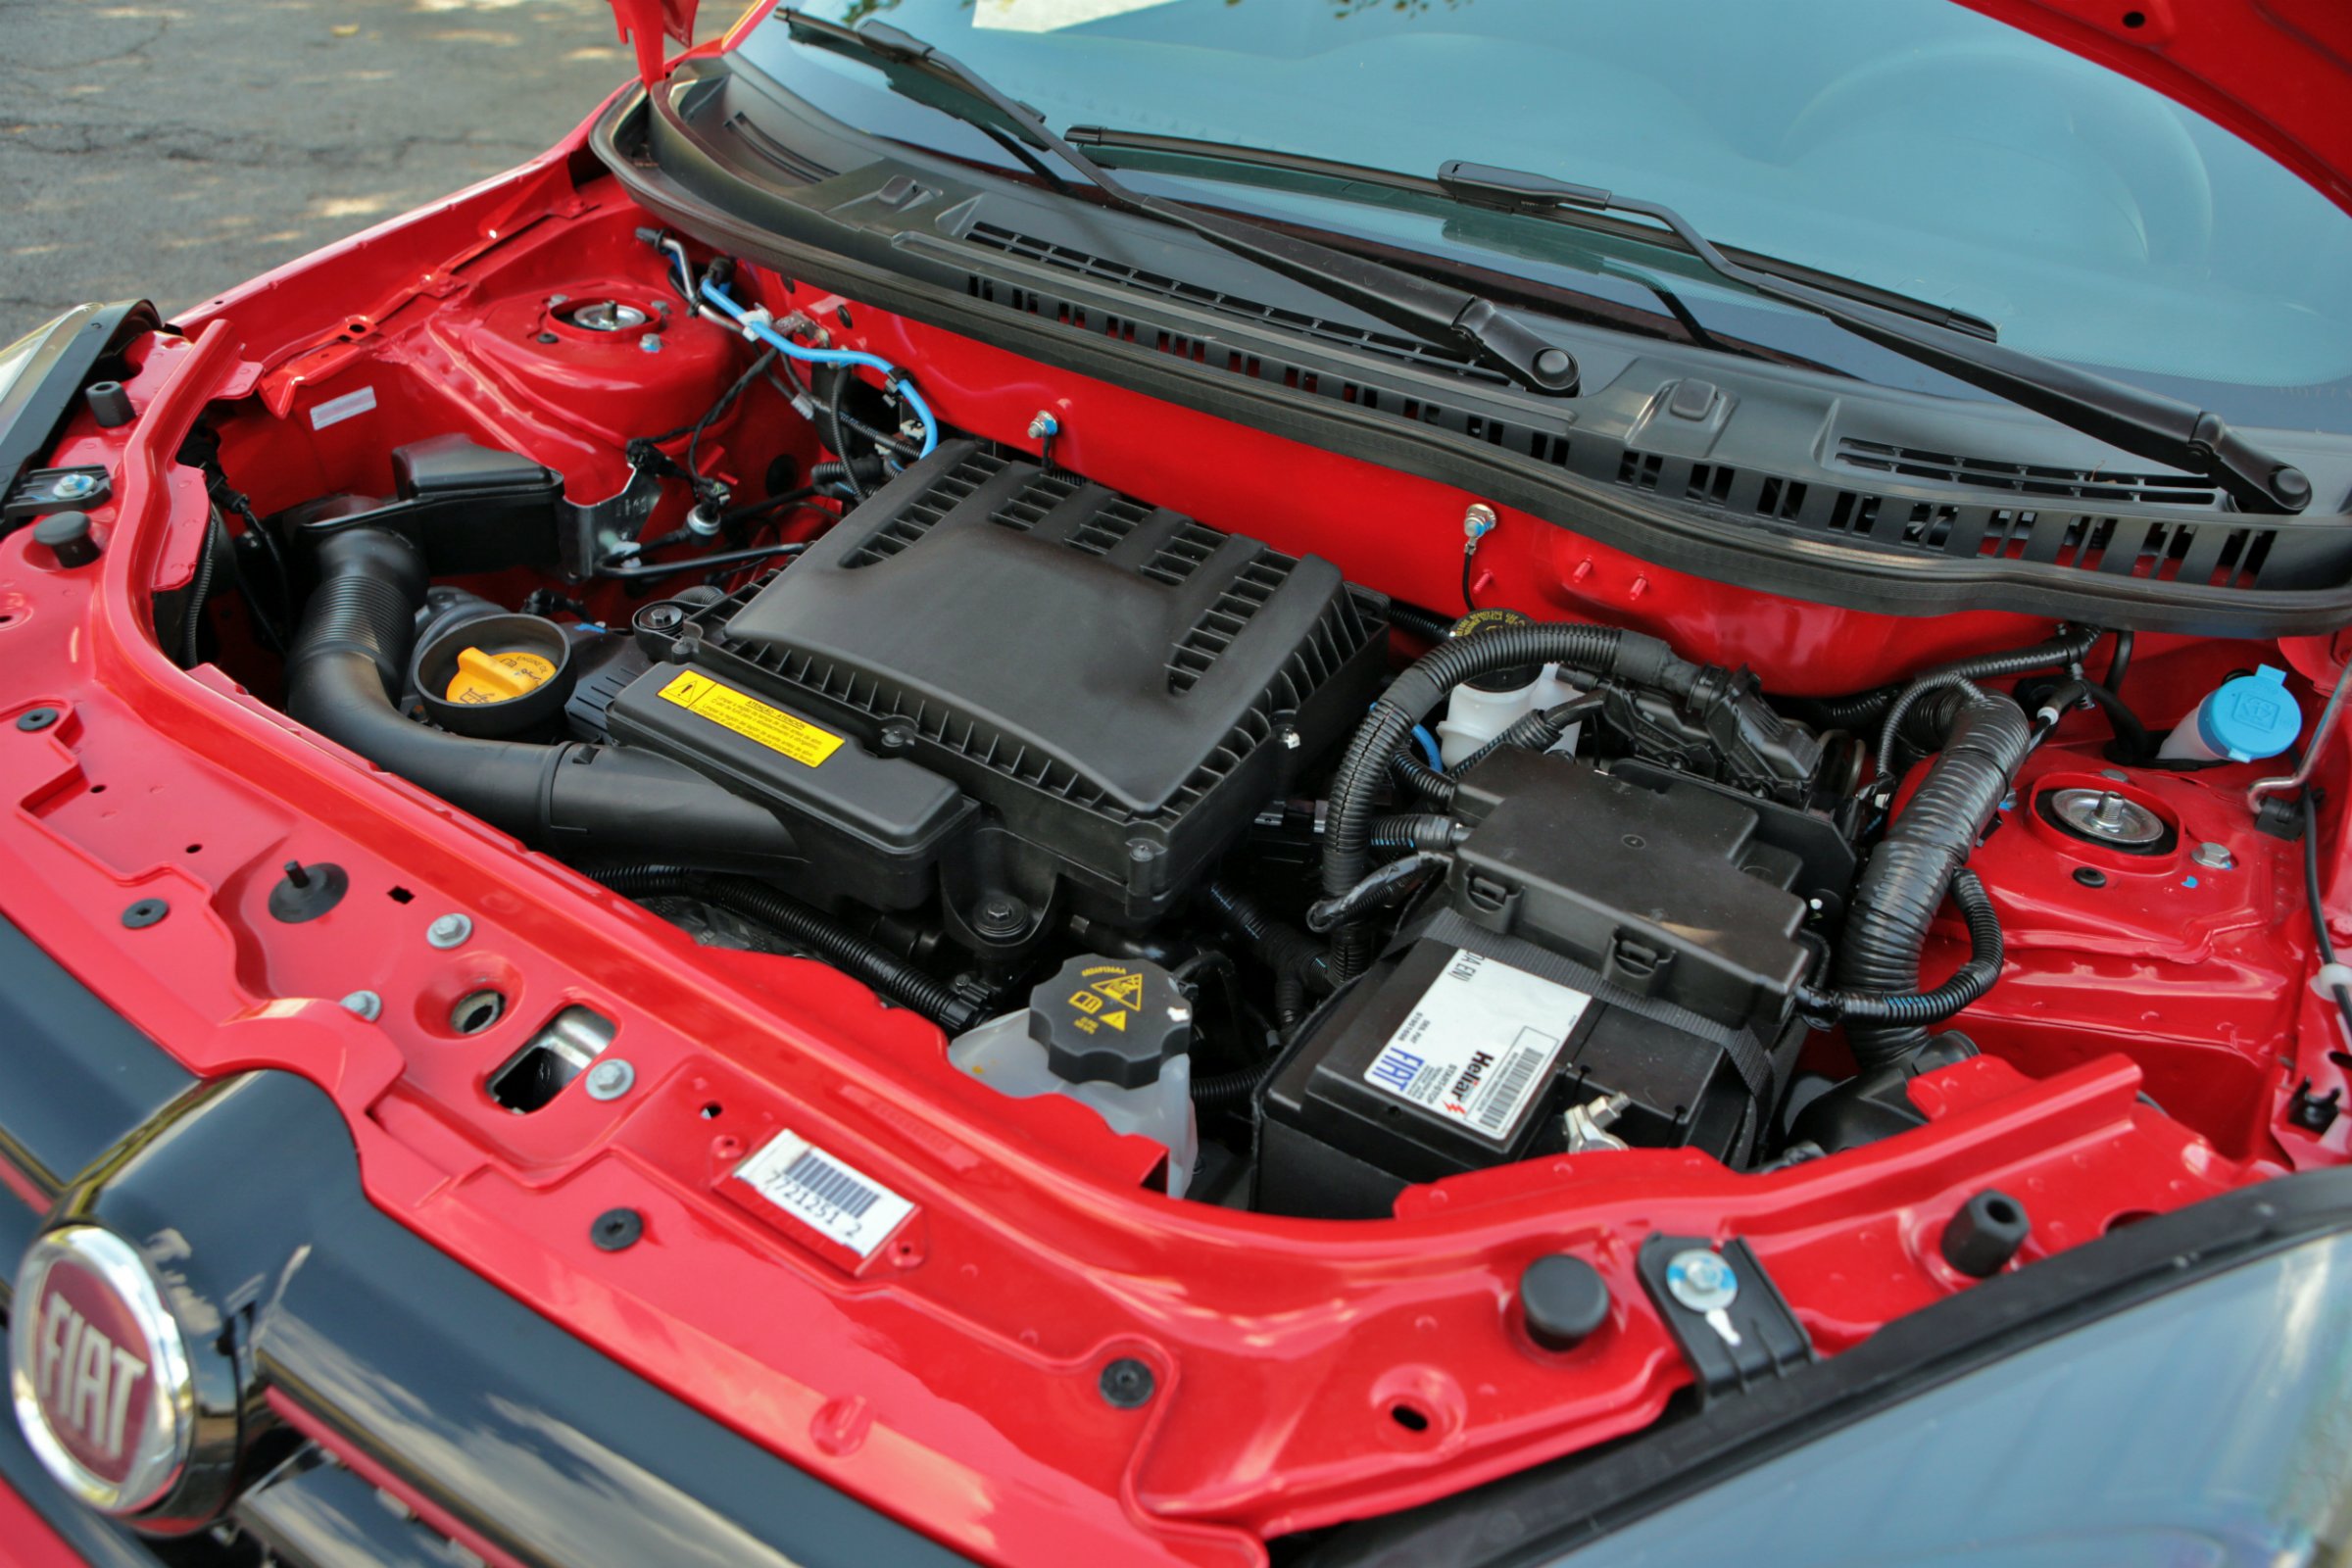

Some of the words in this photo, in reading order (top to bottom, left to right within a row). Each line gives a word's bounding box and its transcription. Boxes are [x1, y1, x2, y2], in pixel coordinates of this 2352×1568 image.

[1372, 1047, 1425, 1092] FIAT
[1450, 1050, 1495, 1102] Heliar
[38, 1291, 148, 1458] FIAT
